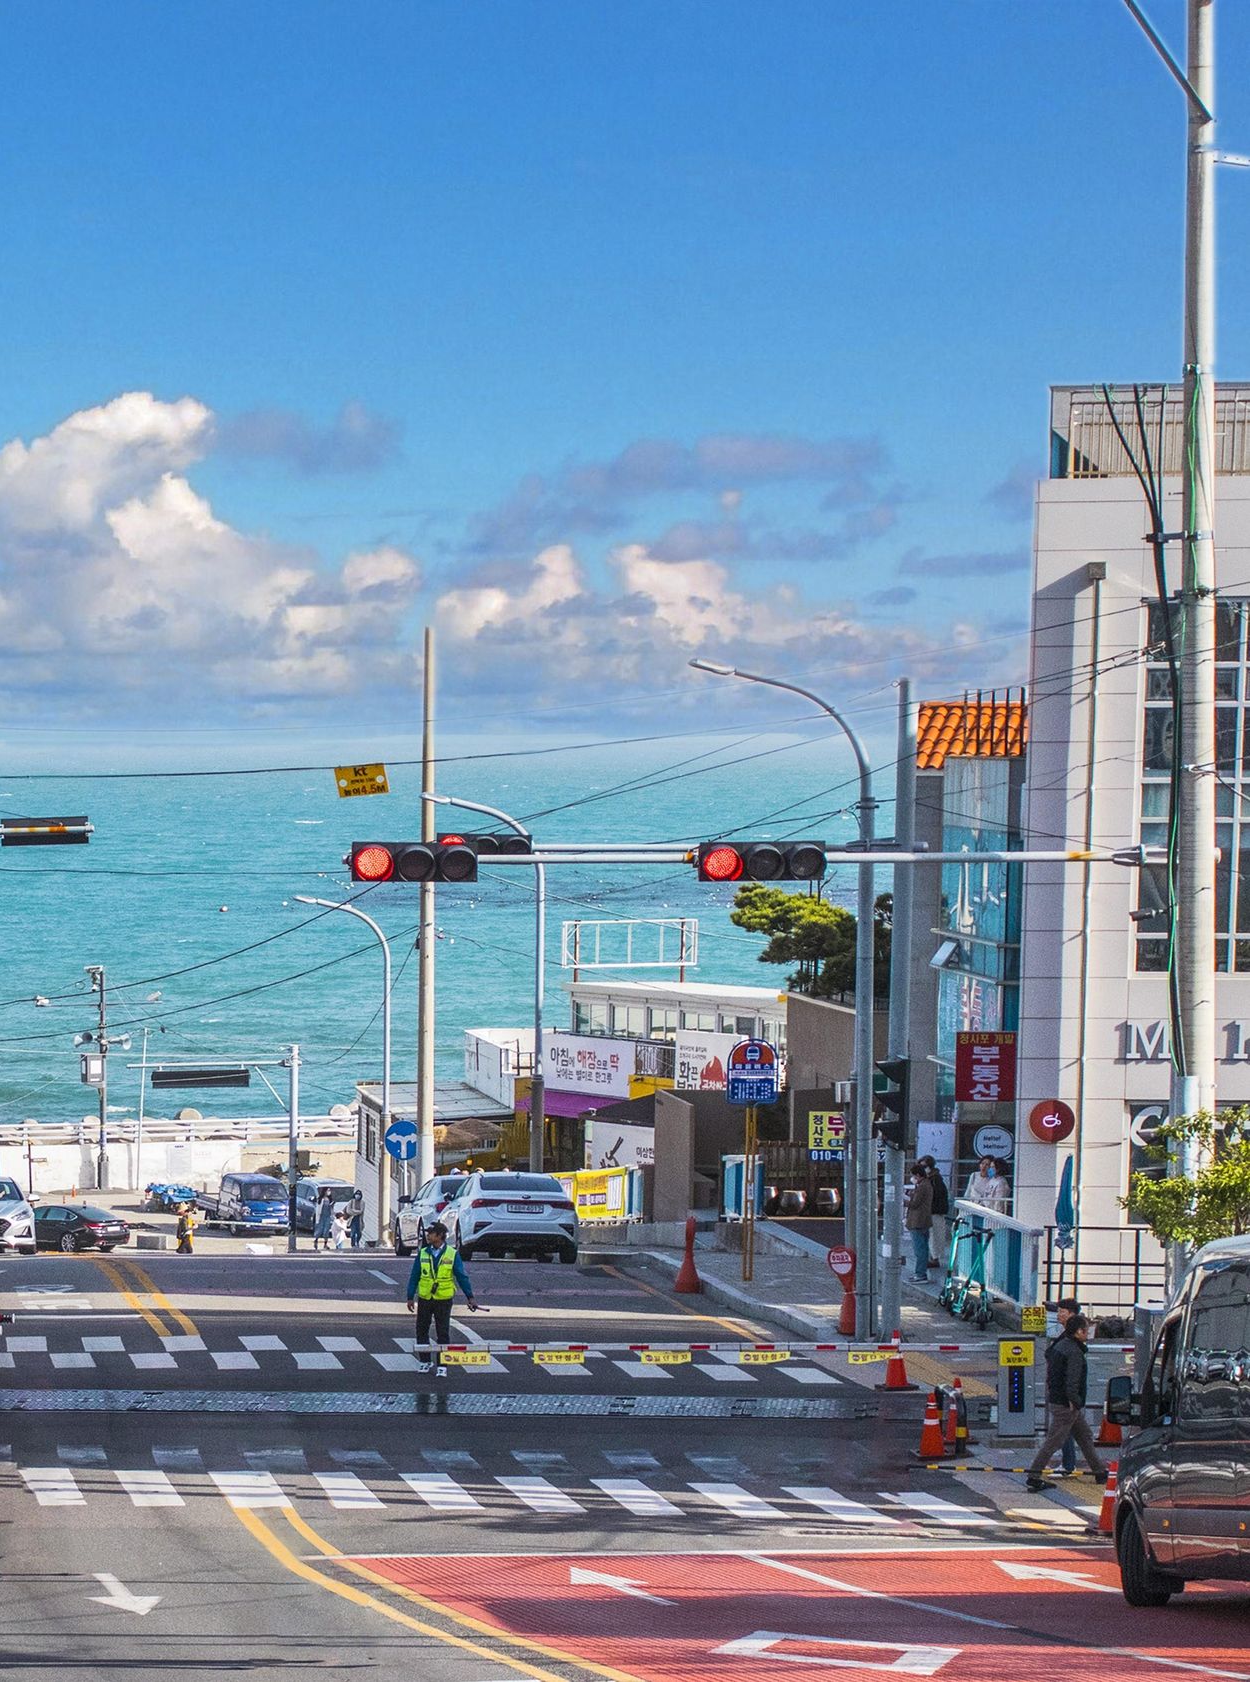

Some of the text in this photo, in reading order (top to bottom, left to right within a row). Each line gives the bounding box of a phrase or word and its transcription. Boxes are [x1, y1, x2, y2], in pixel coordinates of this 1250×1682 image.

[960, 1033, 990, 1045] 청사포
[550, 1046, 576, 1068] 아침에
[576, 1049, 609, 1071] 해장으로
[969, 1046, 1001, 1101] 부동산
